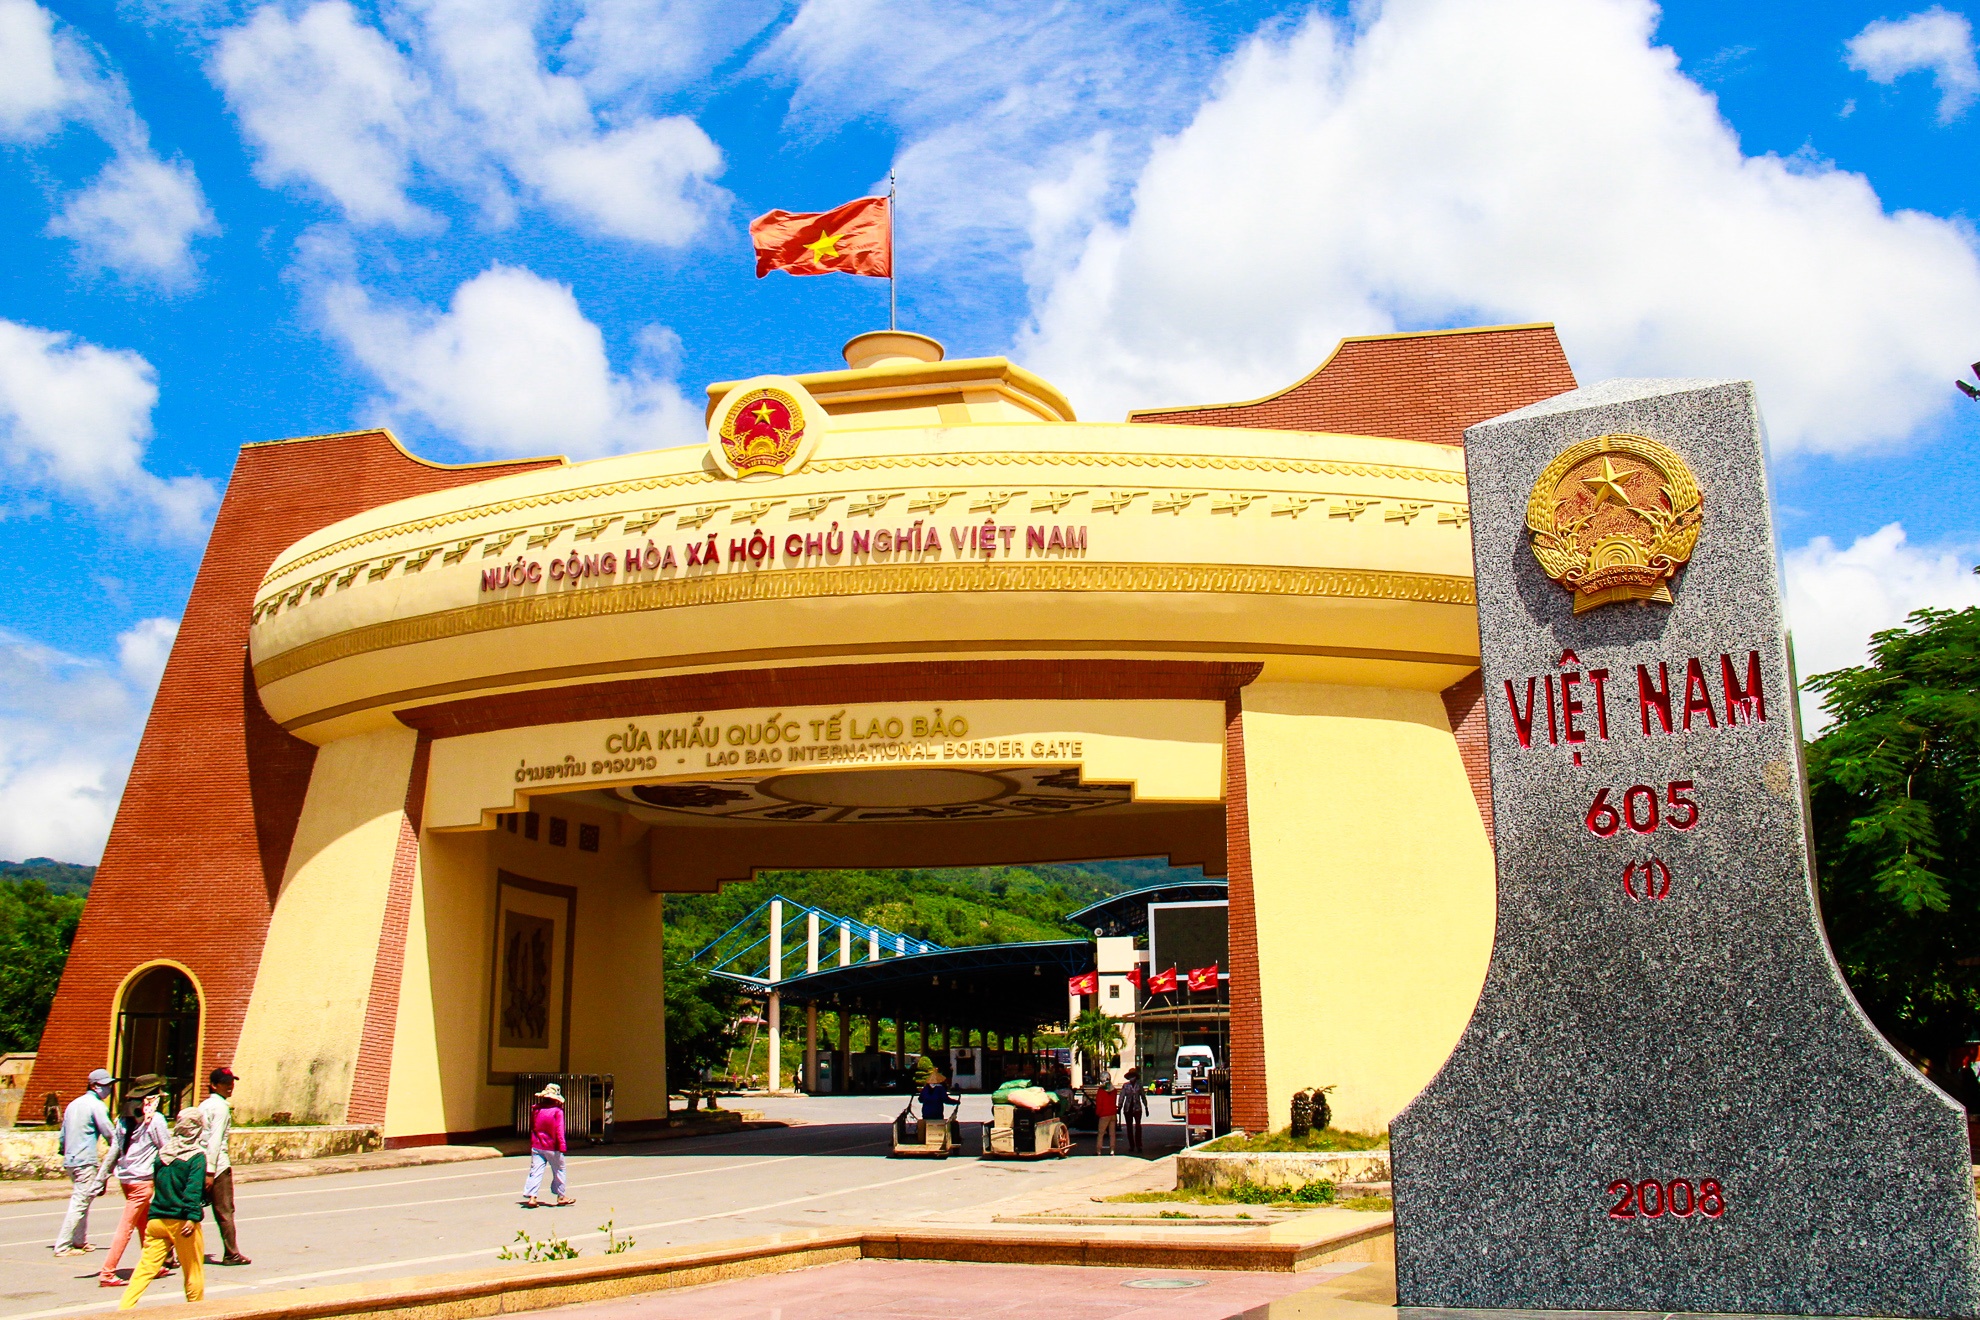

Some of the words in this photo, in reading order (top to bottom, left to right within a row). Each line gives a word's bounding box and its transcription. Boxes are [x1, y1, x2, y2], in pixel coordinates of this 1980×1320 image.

[481, 555, 542, 592] NƯỚC
[550, 549, 617, 587] CỘNG
[625, 539, 678, 574] HÒA
[686, 532, 720, 567] XÃ
[730, 528, 775, 567] HỘI
[785, 521, 844, 557] CHỦ
[852, 519, 942, 554] NGHĨA
[950, 517, 1016, 558] VIỆT
[1026, 525, 1088, 552] NAM
[605, 723, 652, 755] CỬA
[658, 716, 720, 750] KHẨU
[726, 713, 801, 746] QUỐC
[809, 709, 846, 742] TẾ
[850, 716, 904, 740] LAO
[911, 707, 969, 738] BẢO
[1503, 648, 1610, 767] VIỆT
[1637, 650, 1766, 736] NAM
[706, 750, 740, 767] LAO
[745, 747, 783, 765] BAO
[788, 741, 937, 762] INTERNATIONAL
[943, 740, 1025, 759] BORDER
[1031, 740, 1083, 758] GATE
[1586, 780, 1699, 838] 605
[1623, 856, 1671, 902] (1)
[1608, 1178, 1726, 1218] 2008
